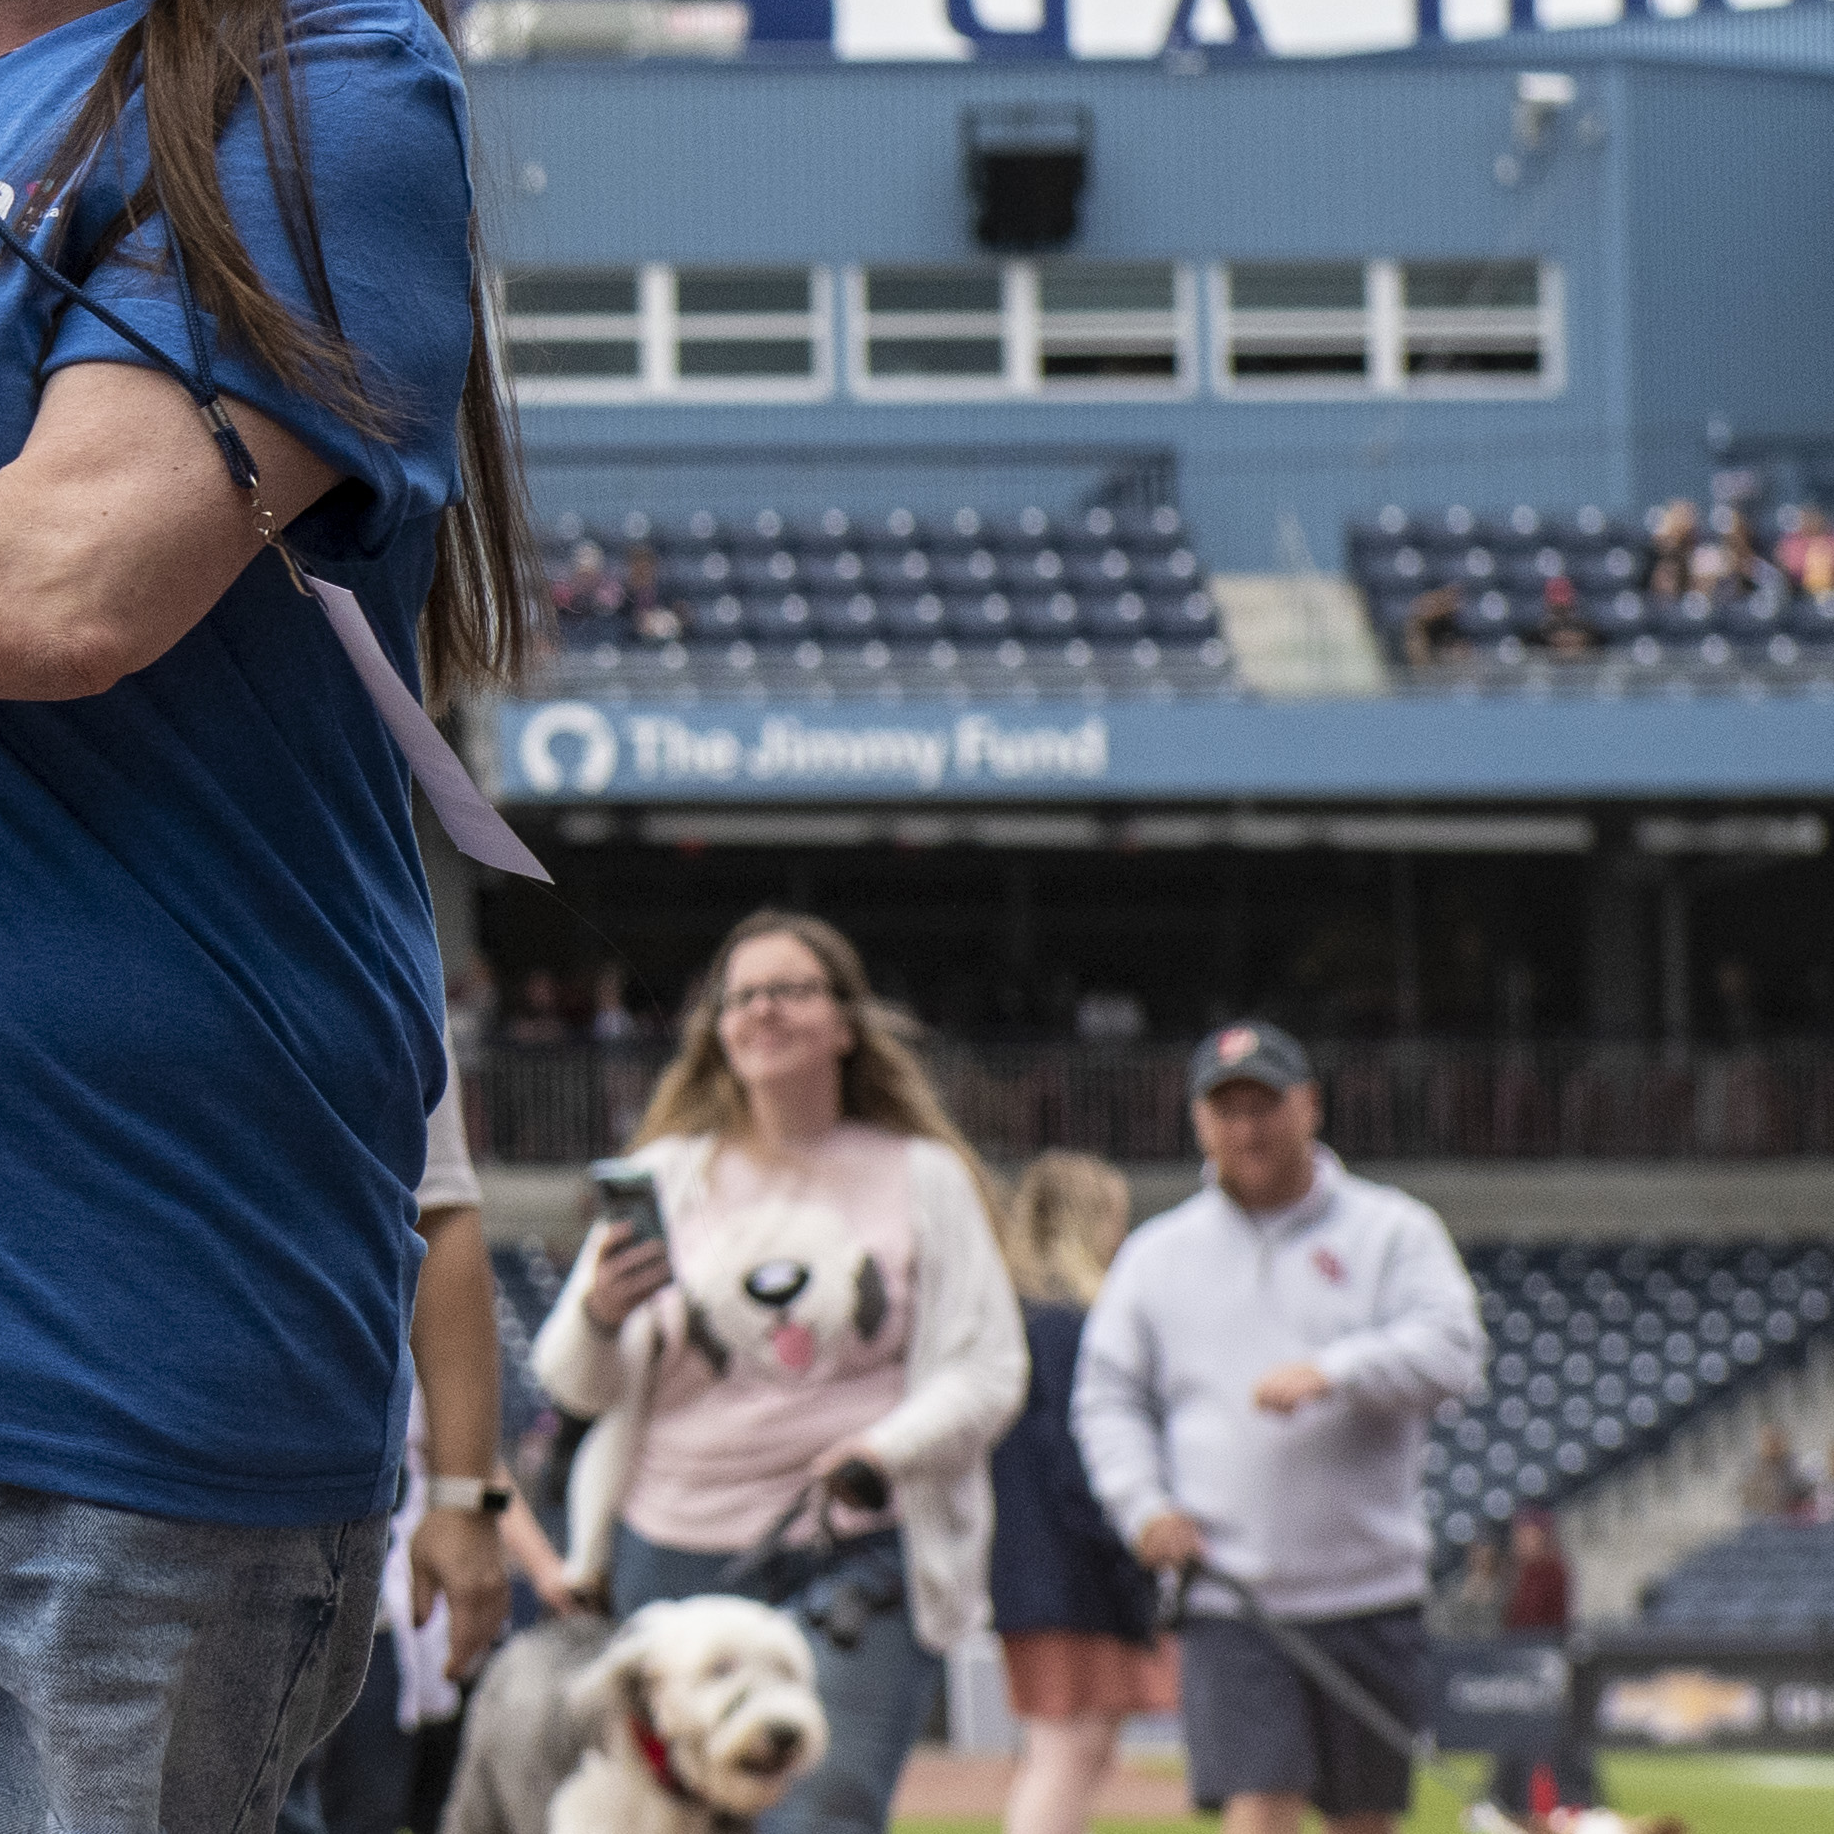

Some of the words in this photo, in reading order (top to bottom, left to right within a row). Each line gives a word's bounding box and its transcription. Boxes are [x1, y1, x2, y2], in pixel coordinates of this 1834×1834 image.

[634, 714, 741, 780] The
[745, 714, 944, 792] Jimmy
[954, 712, 1110, 780] Fund
